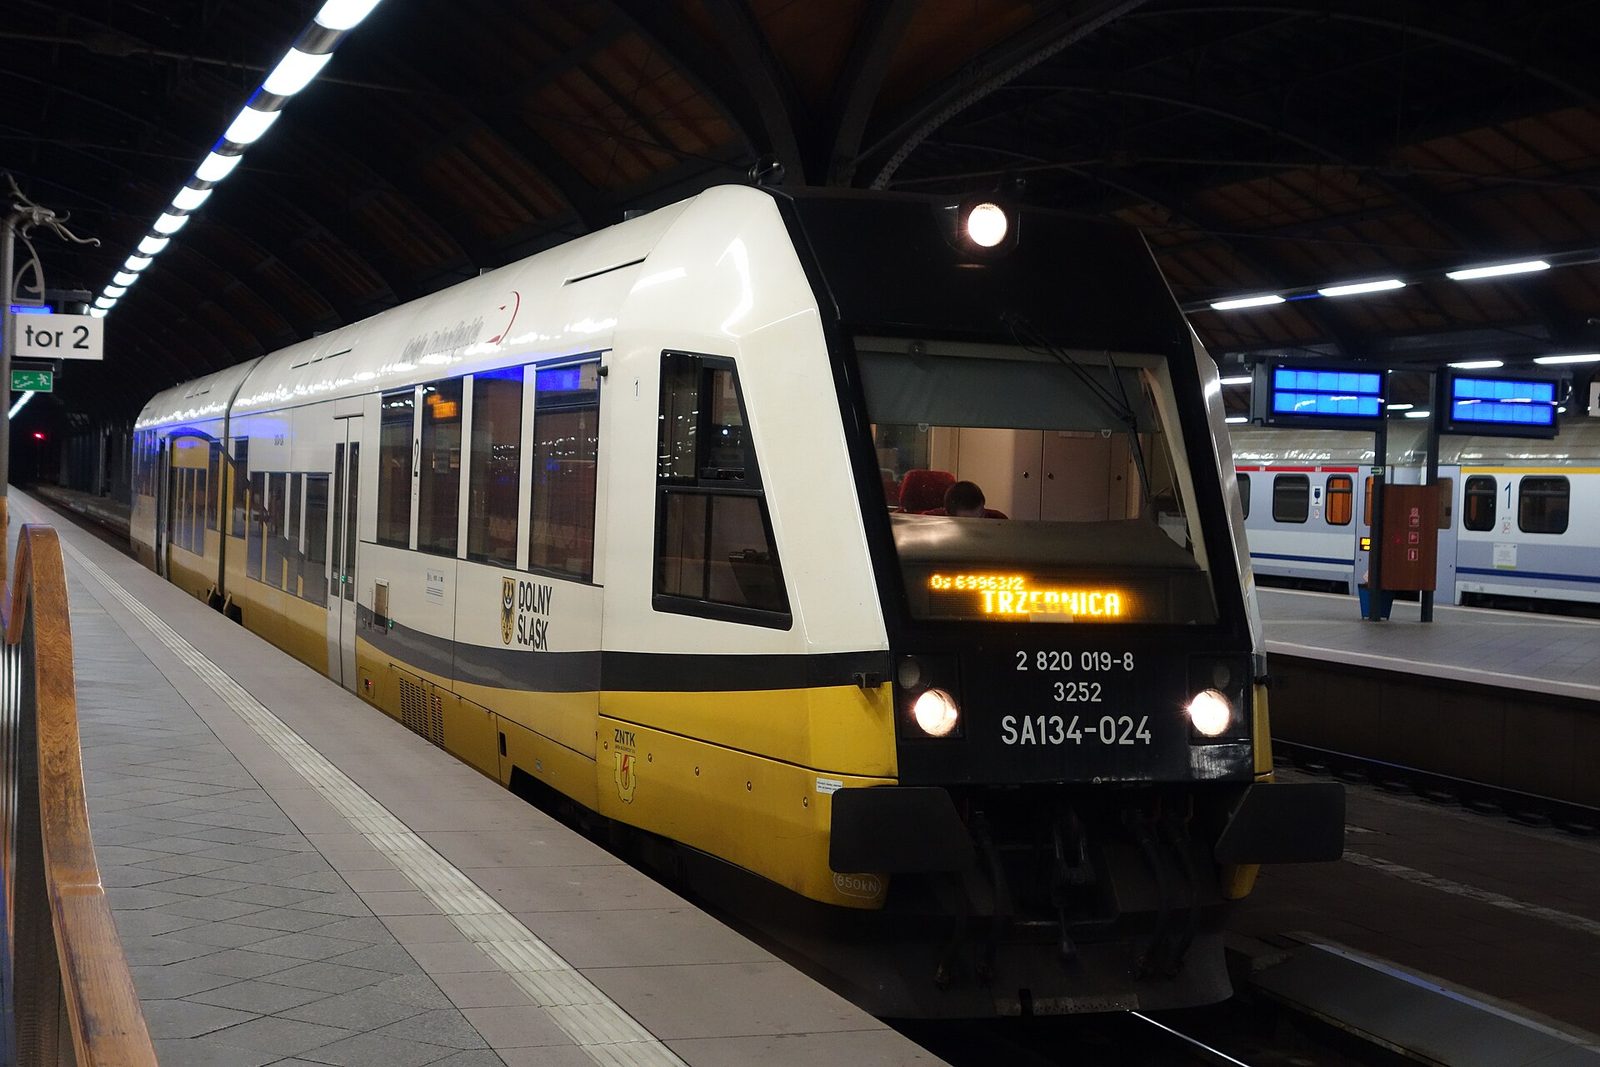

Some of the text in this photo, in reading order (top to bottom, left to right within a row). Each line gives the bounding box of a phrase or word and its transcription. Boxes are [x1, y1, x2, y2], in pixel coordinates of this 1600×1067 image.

[25, 325, 89, 349] tor 2
[1504, 481, 1512, 509] 1
[519, 580, 552, 616] DOLNY
[981, 590, 1120, 616] TRZEBNICA
[517, 608, 549, 652] ŚLĄSK
[1016, 651, 1134, 671] 2 820 019-8
[1053, 682, 1102, 702] 3252
[615, 728, 635, 747] ZNTK
[1001, 715, 1152, 745] SA134-024
